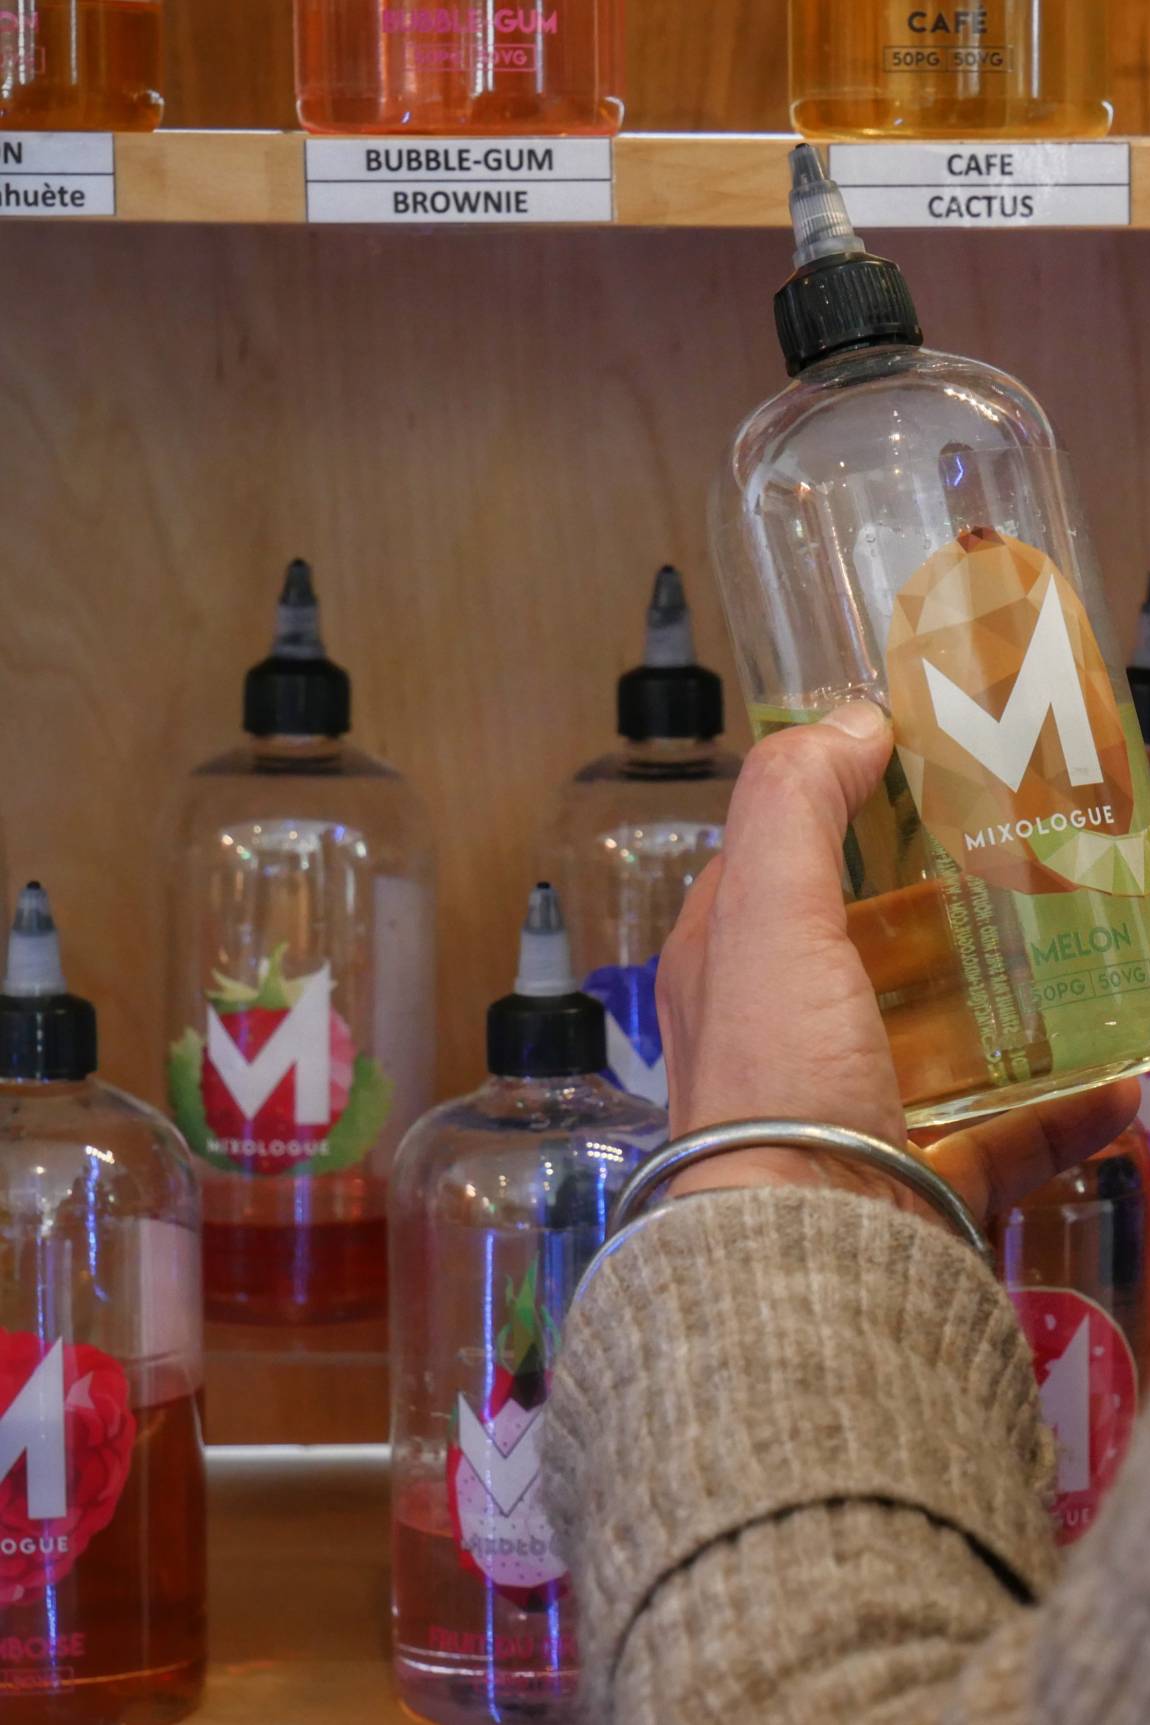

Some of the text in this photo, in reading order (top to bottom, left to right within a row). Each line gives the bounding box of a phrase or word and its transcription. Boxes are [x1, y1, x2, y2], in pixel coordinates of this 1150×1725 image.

[892, 52, 1003, 67] 50PG 50VG
[366, 148, 554, 172] BUBBLE-GUM
[947, 153, 1014, 176] CAFE
[0, 181, 86, 207] huète
[394, 190, 529, 214] BROWNIE
[928, 195, 1034, 219] CACTUS
[964, 805, 1115, 851] MIXOLOGUE
[1030, 922, 1132, 966] MELON
[1031, 966, 1146, 1002] 50PG 50VG
